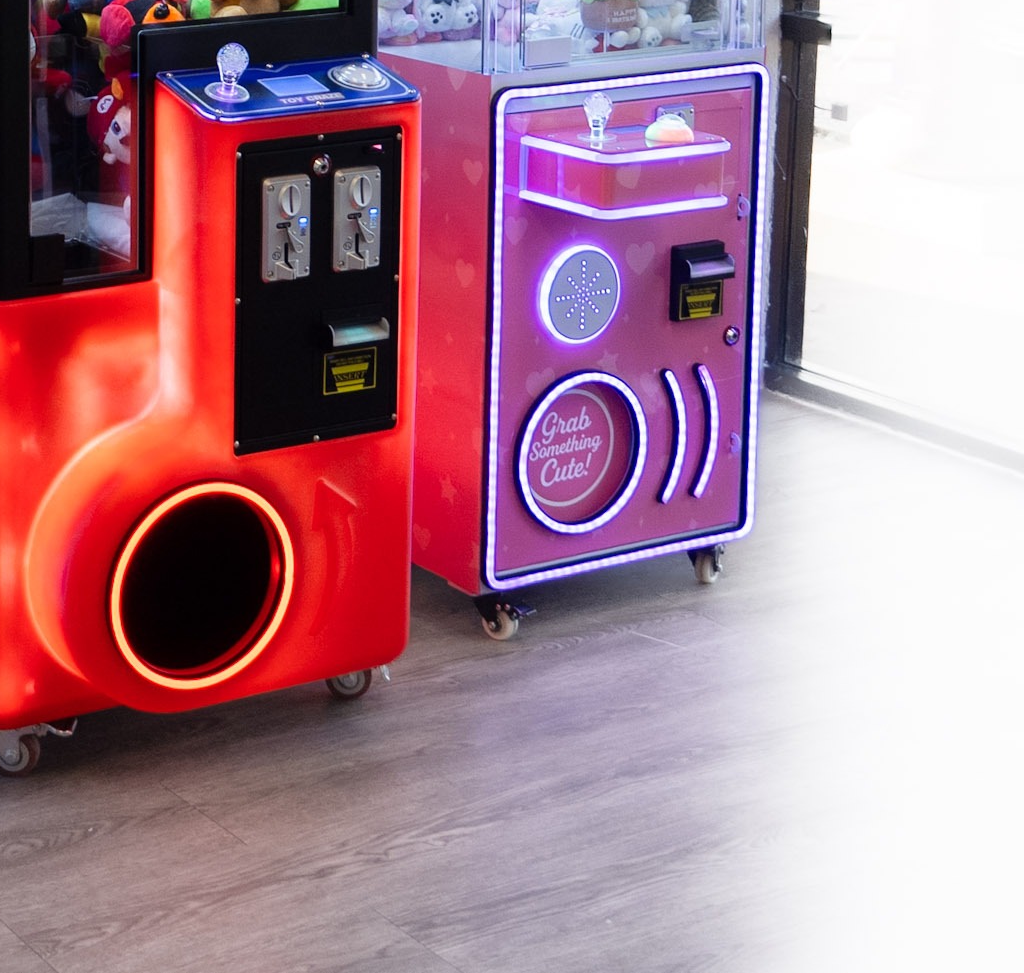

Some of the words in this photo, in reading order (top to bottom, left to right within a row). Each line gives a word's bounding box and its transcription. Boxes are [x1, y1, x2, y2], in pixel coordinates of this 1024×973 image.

[279, 96, 304, 105] TOY
[334, 370, 366, 382] INSERT
[542, 406, 592, 445] Grab
[529, 434, 602, 461] Something
[540, 452, 592, 487] Cute!
